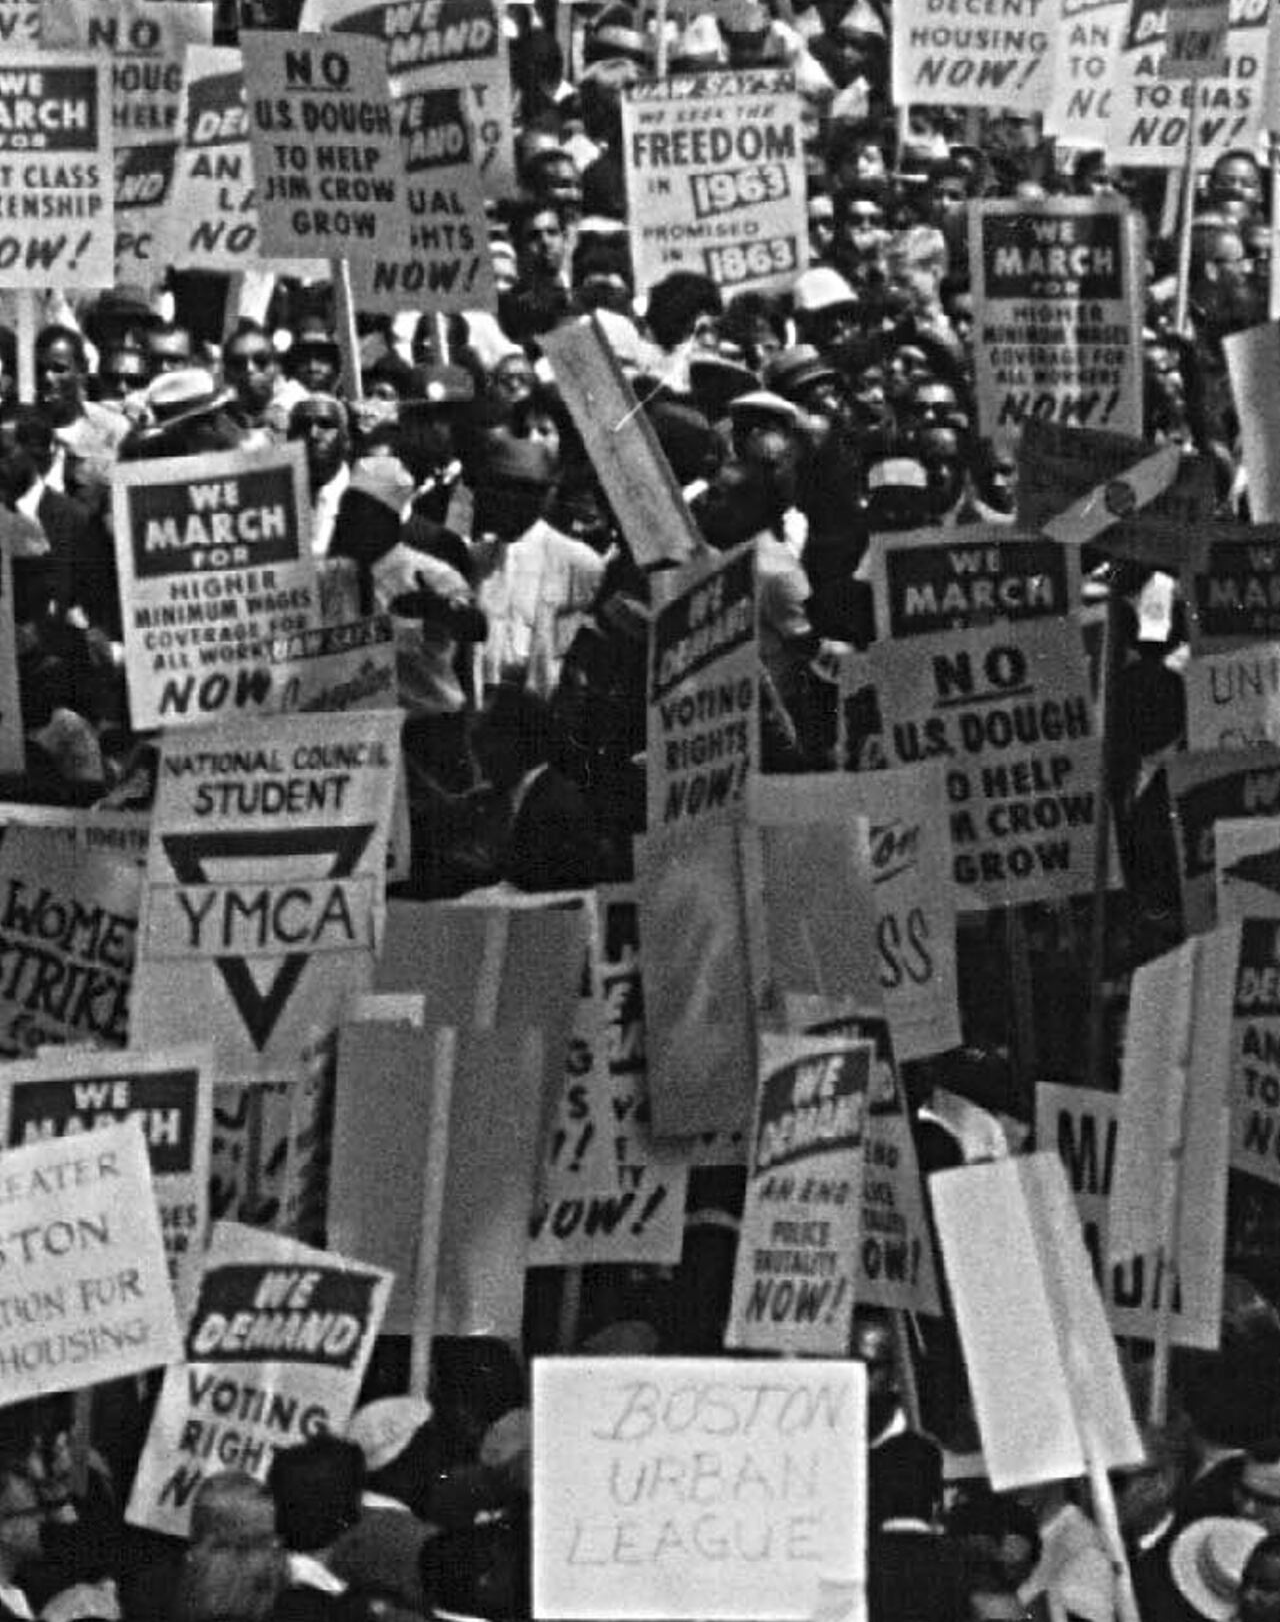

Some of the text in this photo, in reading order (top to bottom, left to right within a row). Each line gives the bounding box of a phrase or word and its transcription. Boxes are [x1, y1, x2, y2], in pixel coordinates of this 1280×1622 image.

[911, 26, 1047, 51] HOUSING
[286, 52, 349, 83] NO
[917, 57, 1040, 88] NOW!
[303, 102, 391, 133] DOUGH
[275, 146, 379, 172] TO HELP
[633, 125, 796, 168] FREEDOM
[23, 165, 99, 188] CLASS
[267, 177, 394, 202] JIM CROW
[695, 165, 784, 212] 1963
[293, 213, 376, 238] GROW
[710, 239, 792, 282] 1863
[146, 506, 285, 550] MARCH
[170, 571, 277, 600] HIGHER
[905, 576, 1054, 616] MARCH
[136, 600, 240, 628] MINIMUM
[934, 647, 1025, 693] NO
[961, 696, 1091, 754] DOUGH
[162, 741, 389, 777] NATIONAL COUNCIL
[194, 775, 349, 815] STUDENT
[954, 842, 1069, 885] GROW
[177, 885, 354, 948] YMCA
[81, 1271, 144, 1315] FOR
[255, 1273, 322, 1308] WE
[0, 1320, 150, 1379] HOUSING
[192, 1313, 359, 1354] DEMAND
[187, 1371, 330, 1439] VOTING
[594, 1382, 847, 1441] BOSTON
[609, 1455, 823, 1507] URBAN
[567, 1518, 819, 1565] LEAGUE
